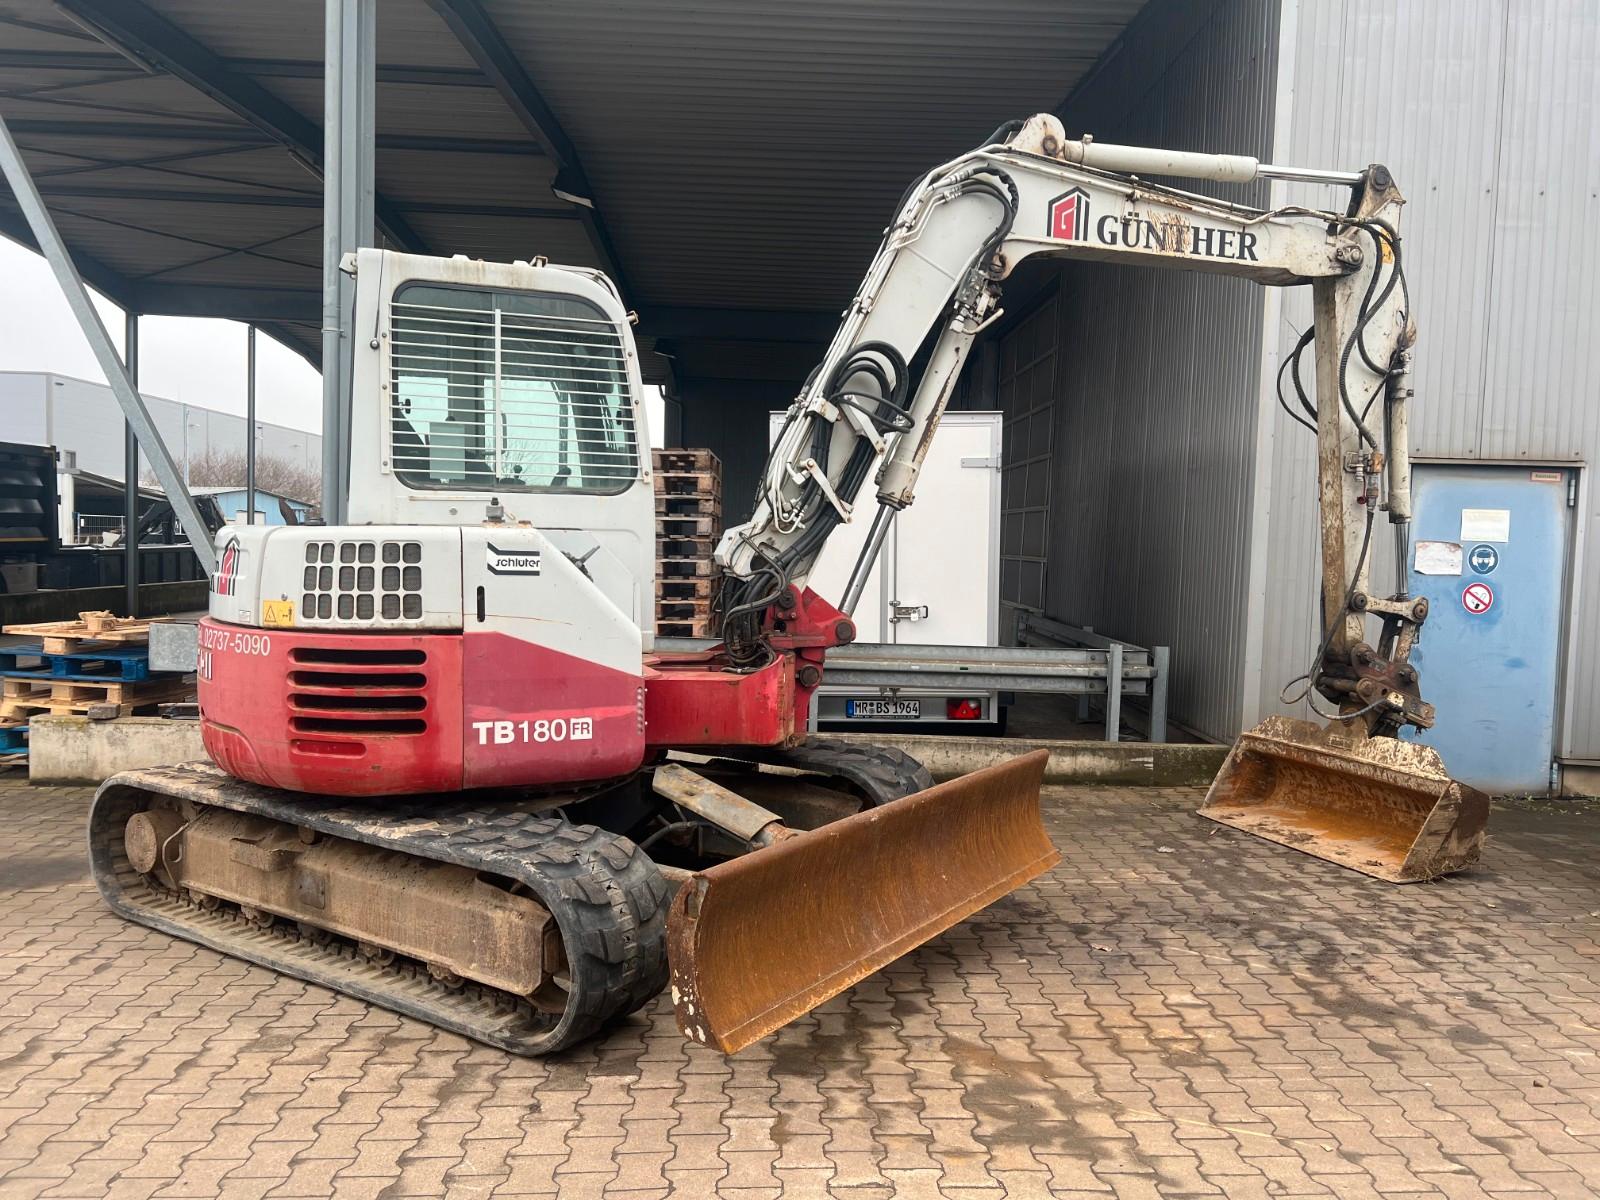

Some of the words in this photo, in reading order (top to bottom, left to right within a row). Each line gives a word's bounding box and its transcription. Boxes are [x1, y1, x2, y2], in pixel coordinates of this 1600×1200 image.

[1097, 211, 1259, 261] GÜNTHER
[204, 627, 271, 656] 02737-5090
[854, 701, 868, 714] MR
[876, 701, 890, 714] BS
[892, 701, 918, 714] 1964
[472, 718, 567, 745] TB180
[571, 720, 592, 737] FR
